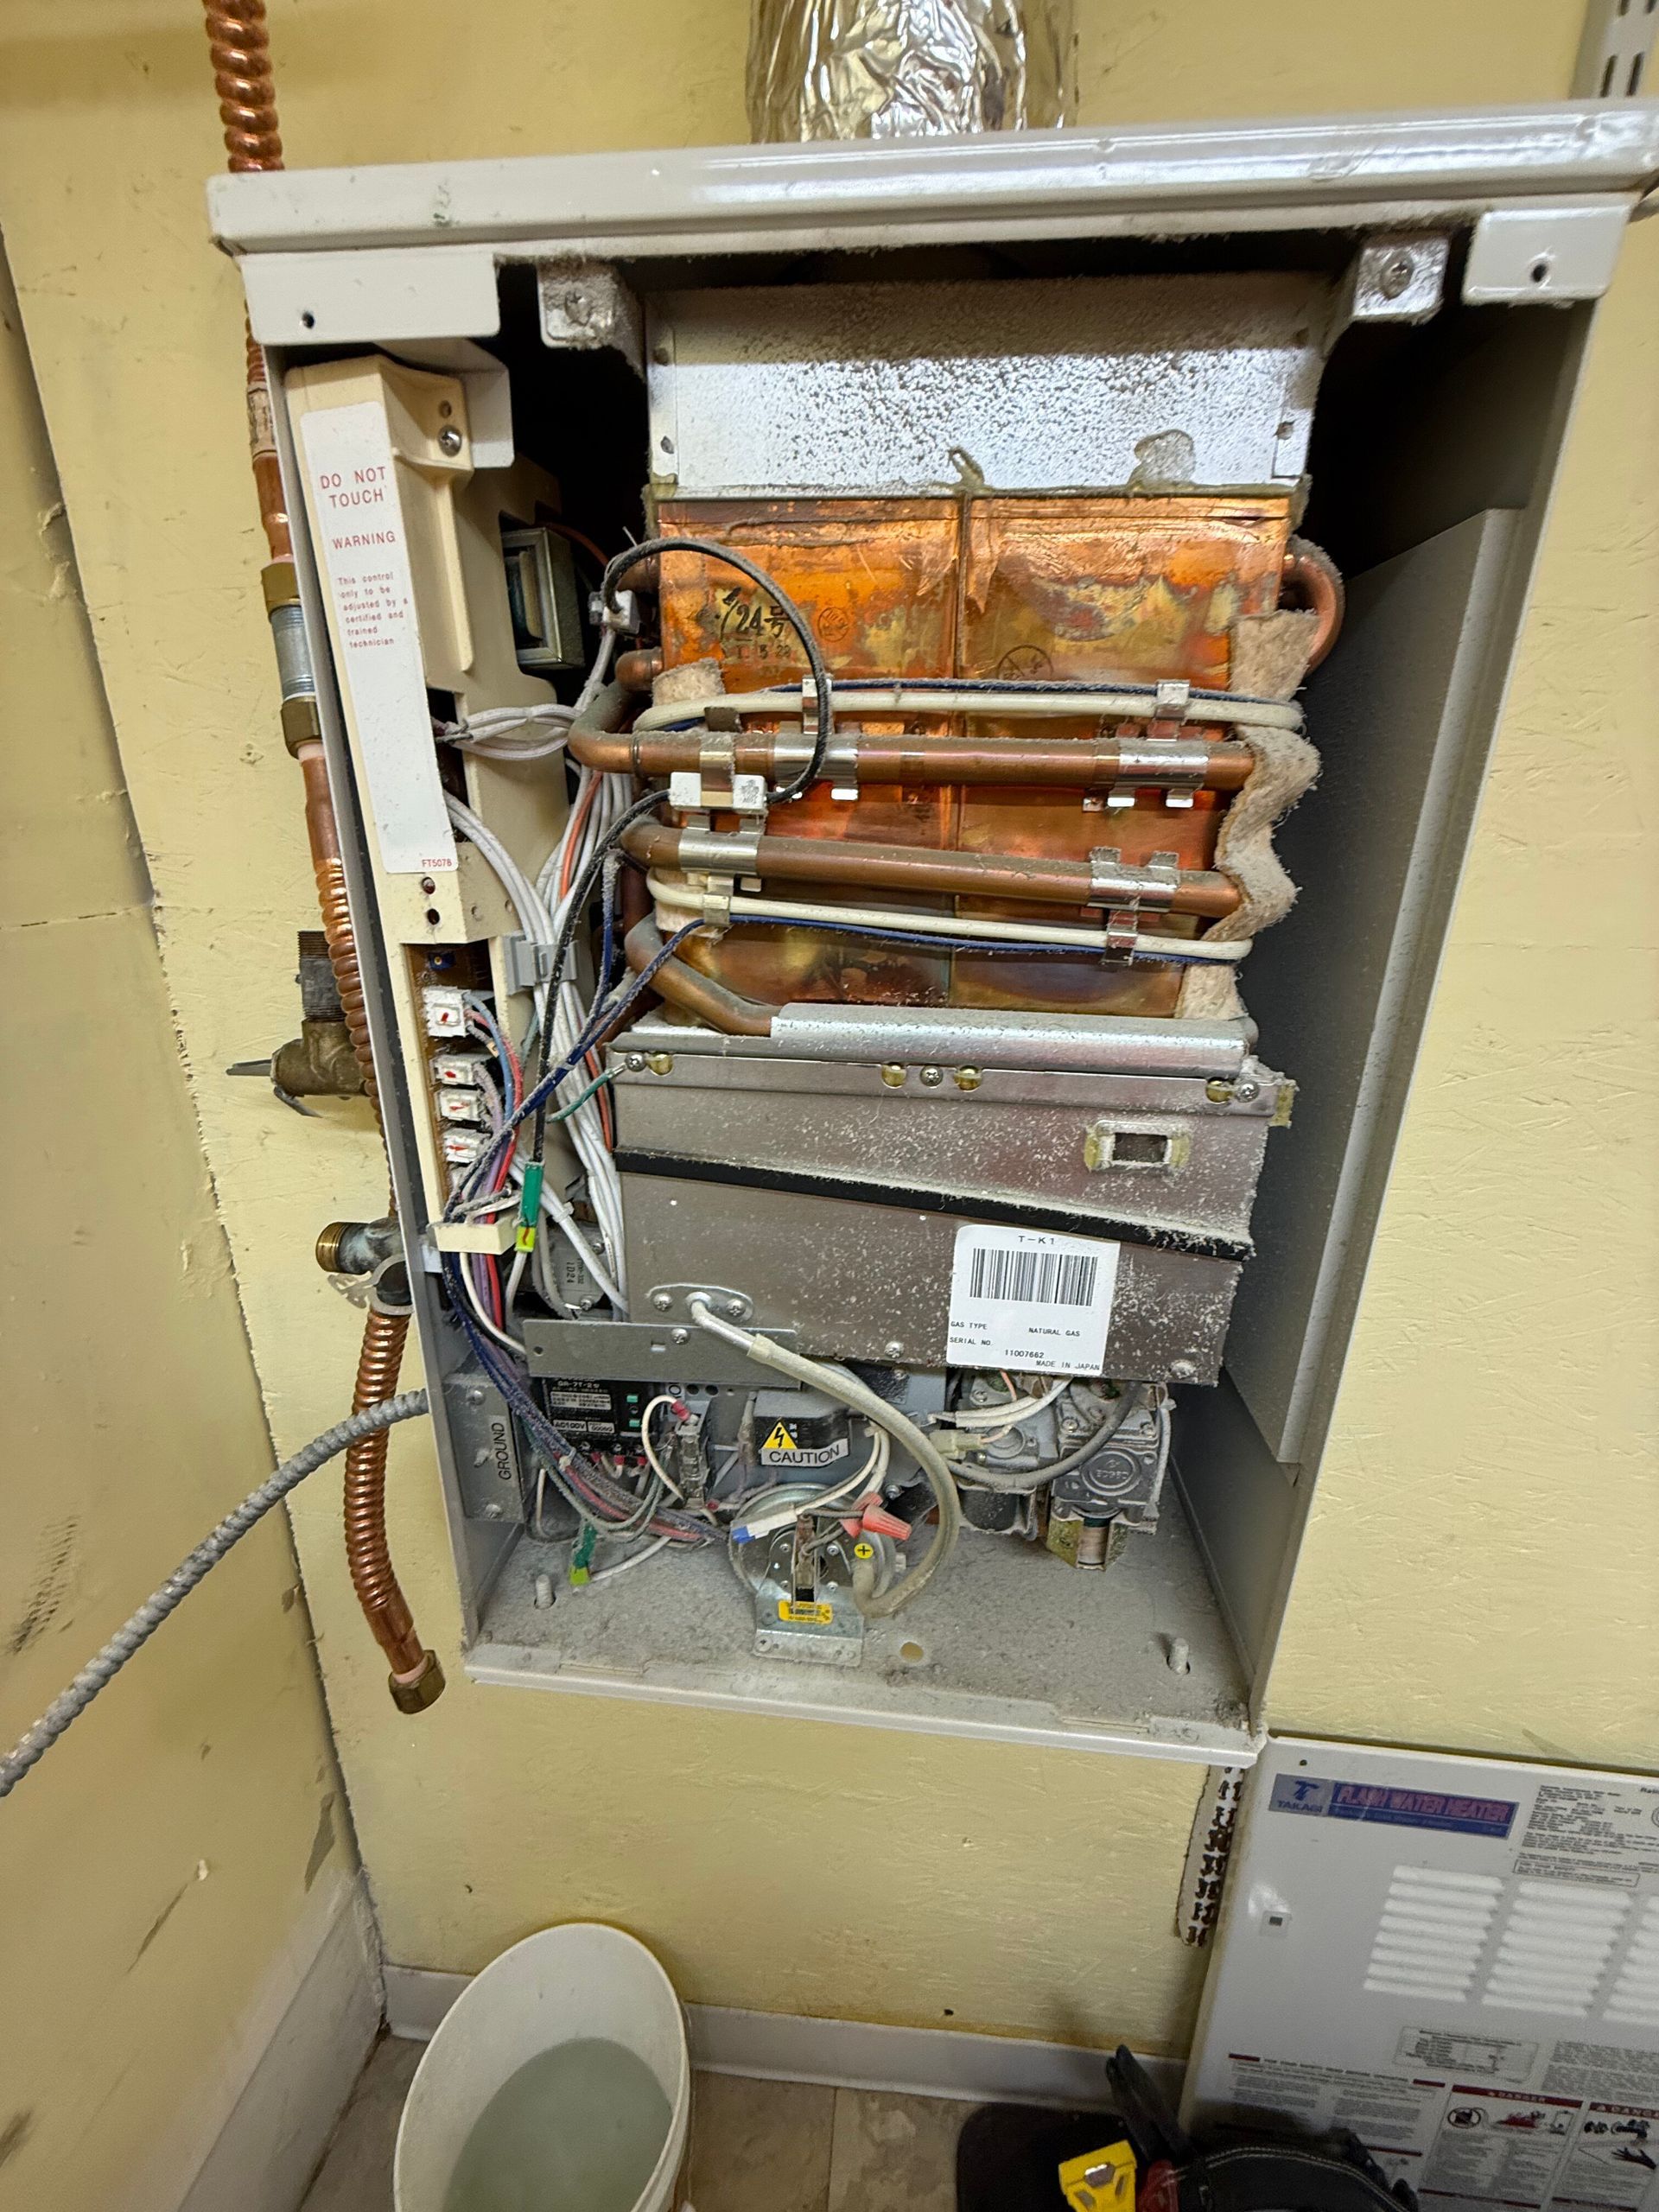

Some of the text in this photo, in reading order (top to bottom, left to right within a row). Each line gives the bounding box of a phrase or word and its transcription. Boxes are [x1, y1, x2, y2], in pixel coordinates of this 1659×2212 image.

[320, 467, 386, 489] DO NOT
[328, 488, 384, 508] TOUCH
[333, 531, 397, 550] WARNING
[337, 572, 394, 585] This control
[340, 590, 358, 599] only
[343, 600, 380, 612] adjusted
[386, 599, 396, 607] by
[346, 613, 382, 623] certified
[346, 626, 378, 636] trained
[349, 638, 394, 648] technician
[1028, 1327, 1061, 1336] NATURAL
[949, 1337, 976, 1345] SERIAL
[1004, 1349, 1045, 1358] 11007662
[491, 1422, 512, 1480] GROUND
[769, 1444, 840, 1464] CAUTION
